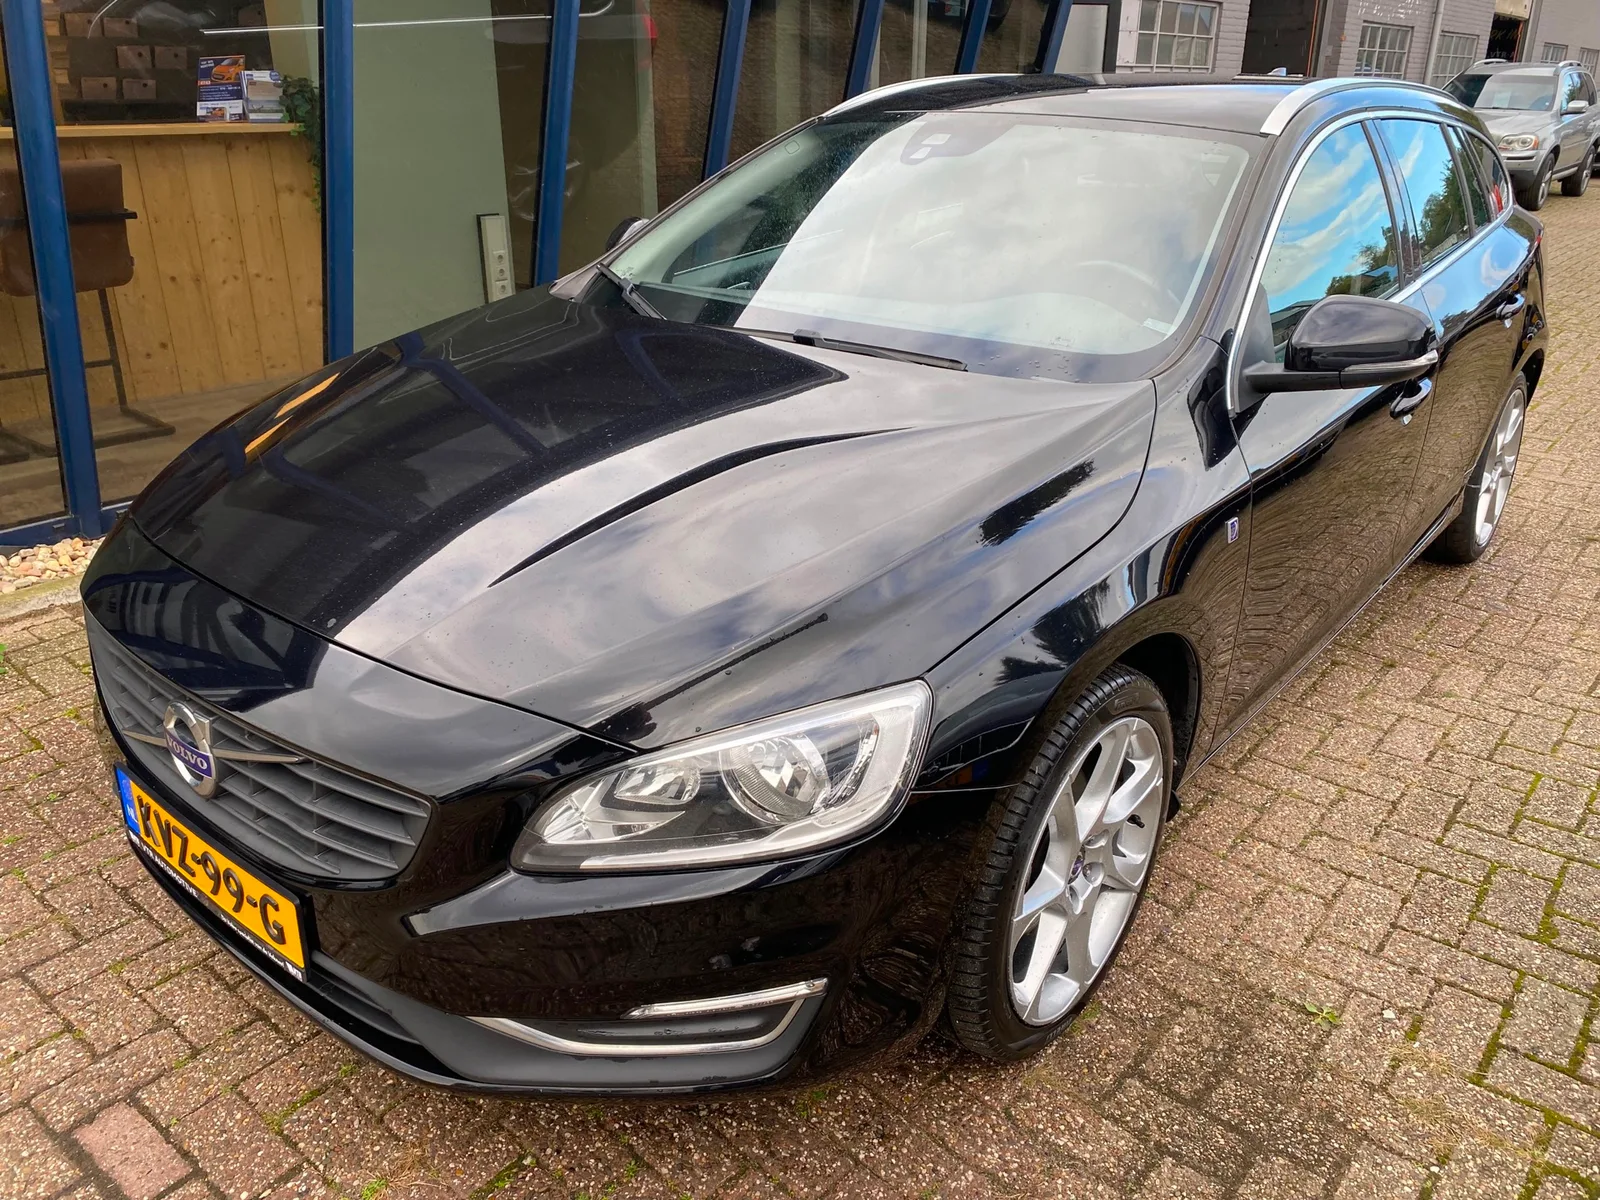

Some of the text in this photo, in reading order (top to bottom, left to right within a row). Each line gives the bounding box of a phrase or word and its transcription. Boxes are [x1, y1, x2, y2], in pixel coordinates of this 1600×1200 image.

[166, 732, 208, 770] VOLVO
[126, 803, 138, 823] NL
[136, 794, 287, 946] KVZ-99-G
